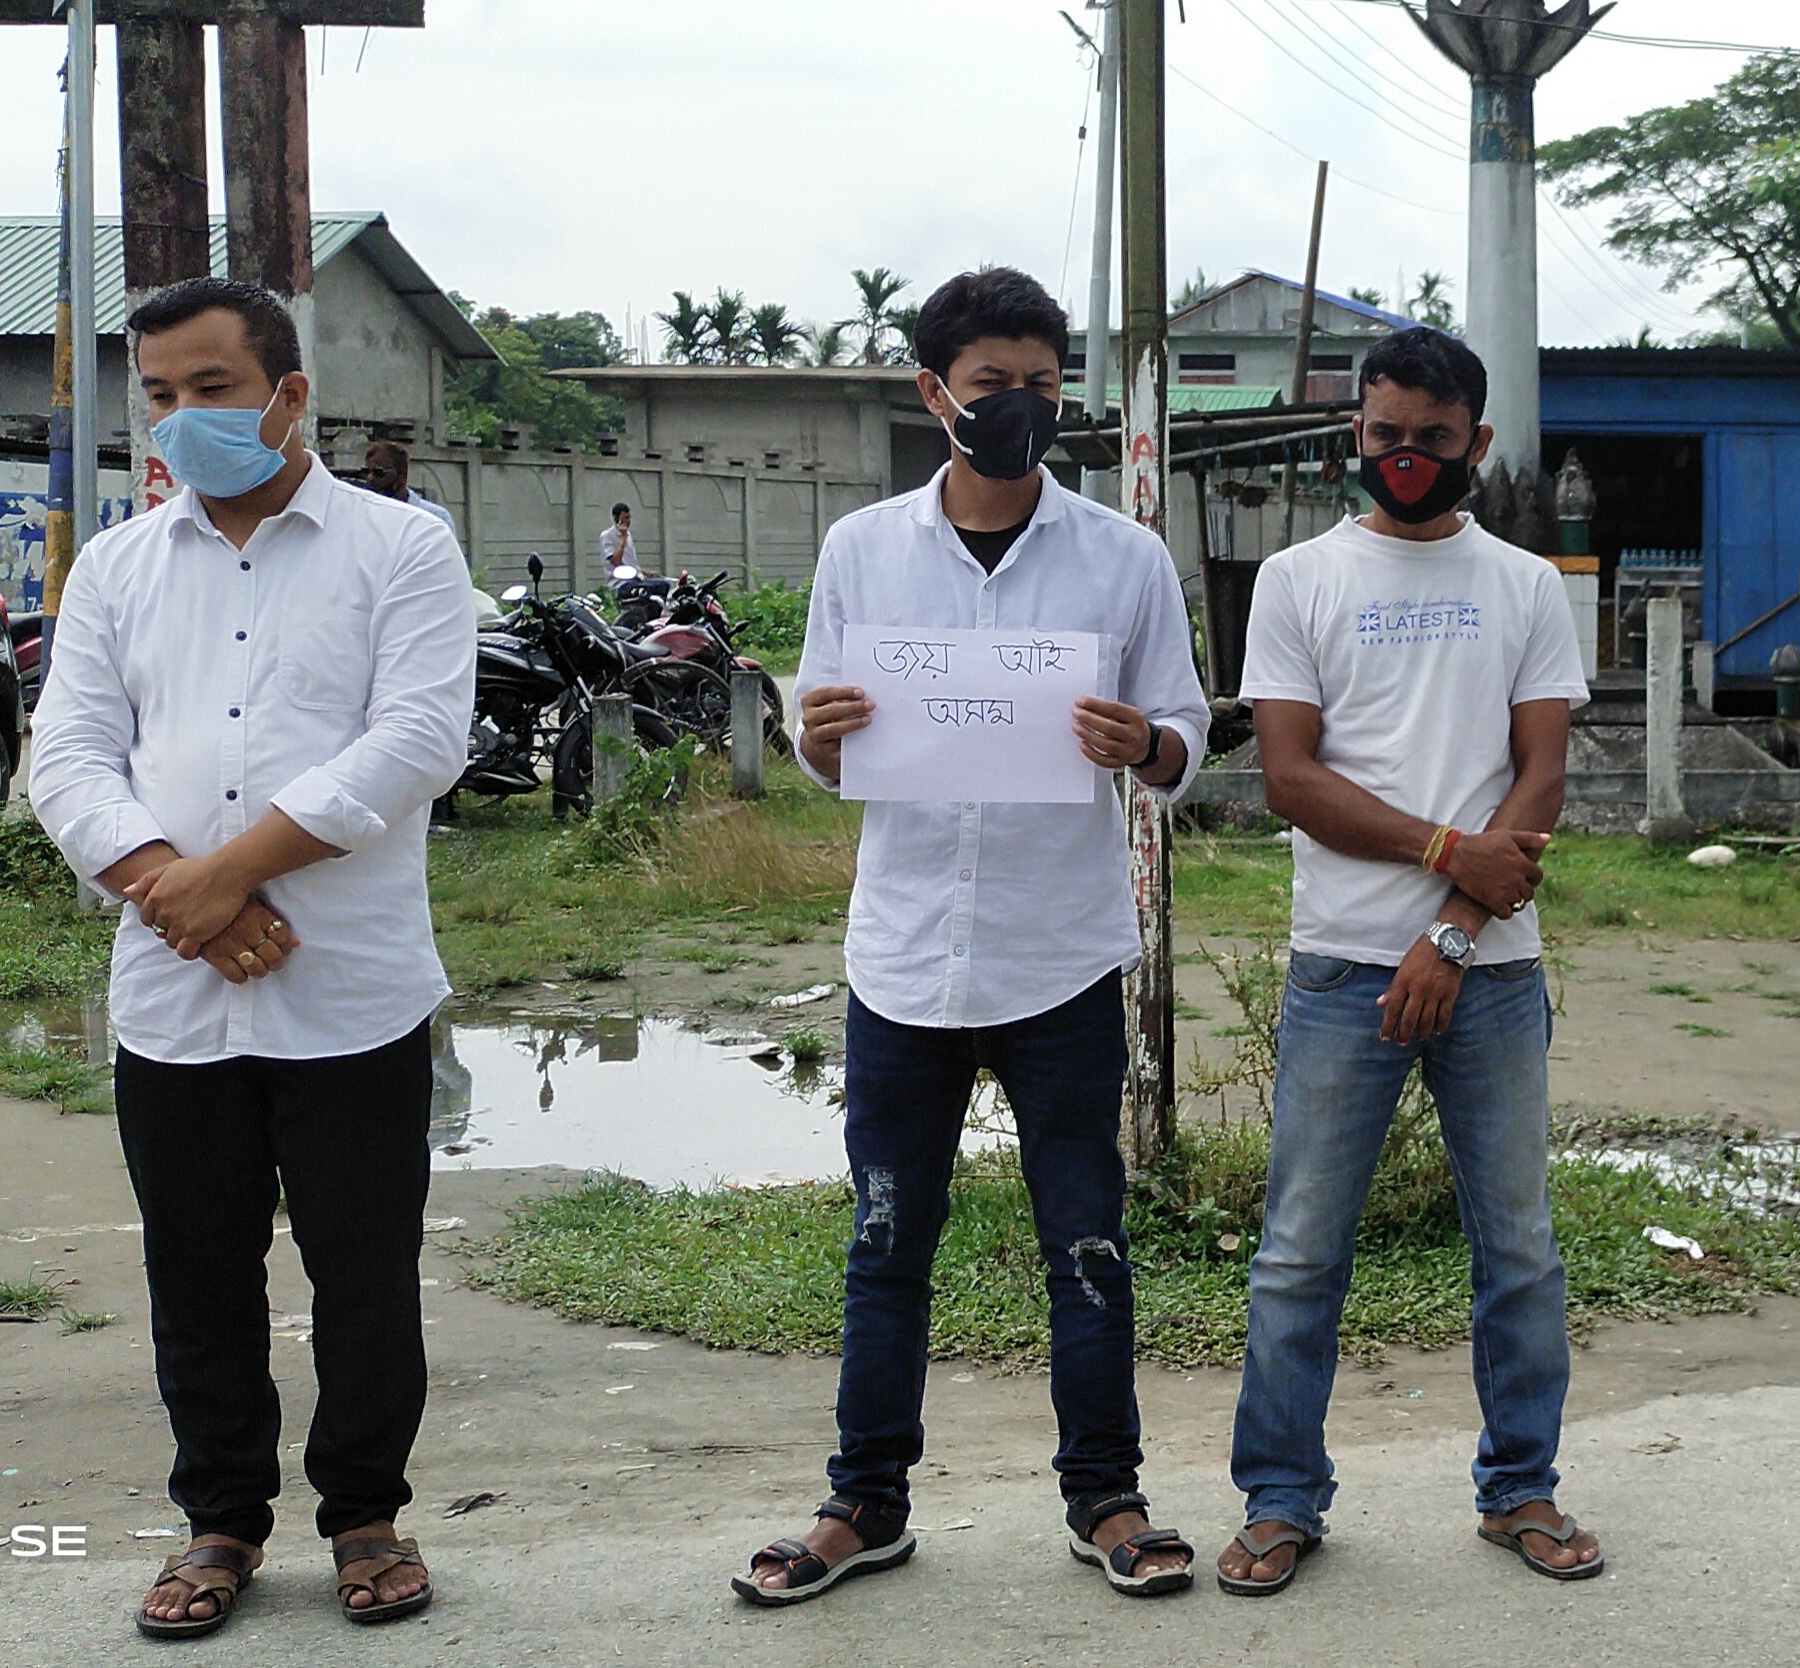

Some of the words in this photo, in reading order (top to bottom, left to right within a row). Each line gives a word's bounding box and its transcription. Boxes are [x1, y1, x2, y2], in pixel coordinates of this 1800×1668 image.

[1385, 611, 1455, 630] LATEST
[1361, 636, 1384, 645] NEW
[1390, 634, 1439, 644] FASHION
[1444, 632, 1479, 641] STYLE
[991, 638, 1077, 676] আই
[920, 698, 1014, 728] অসম
